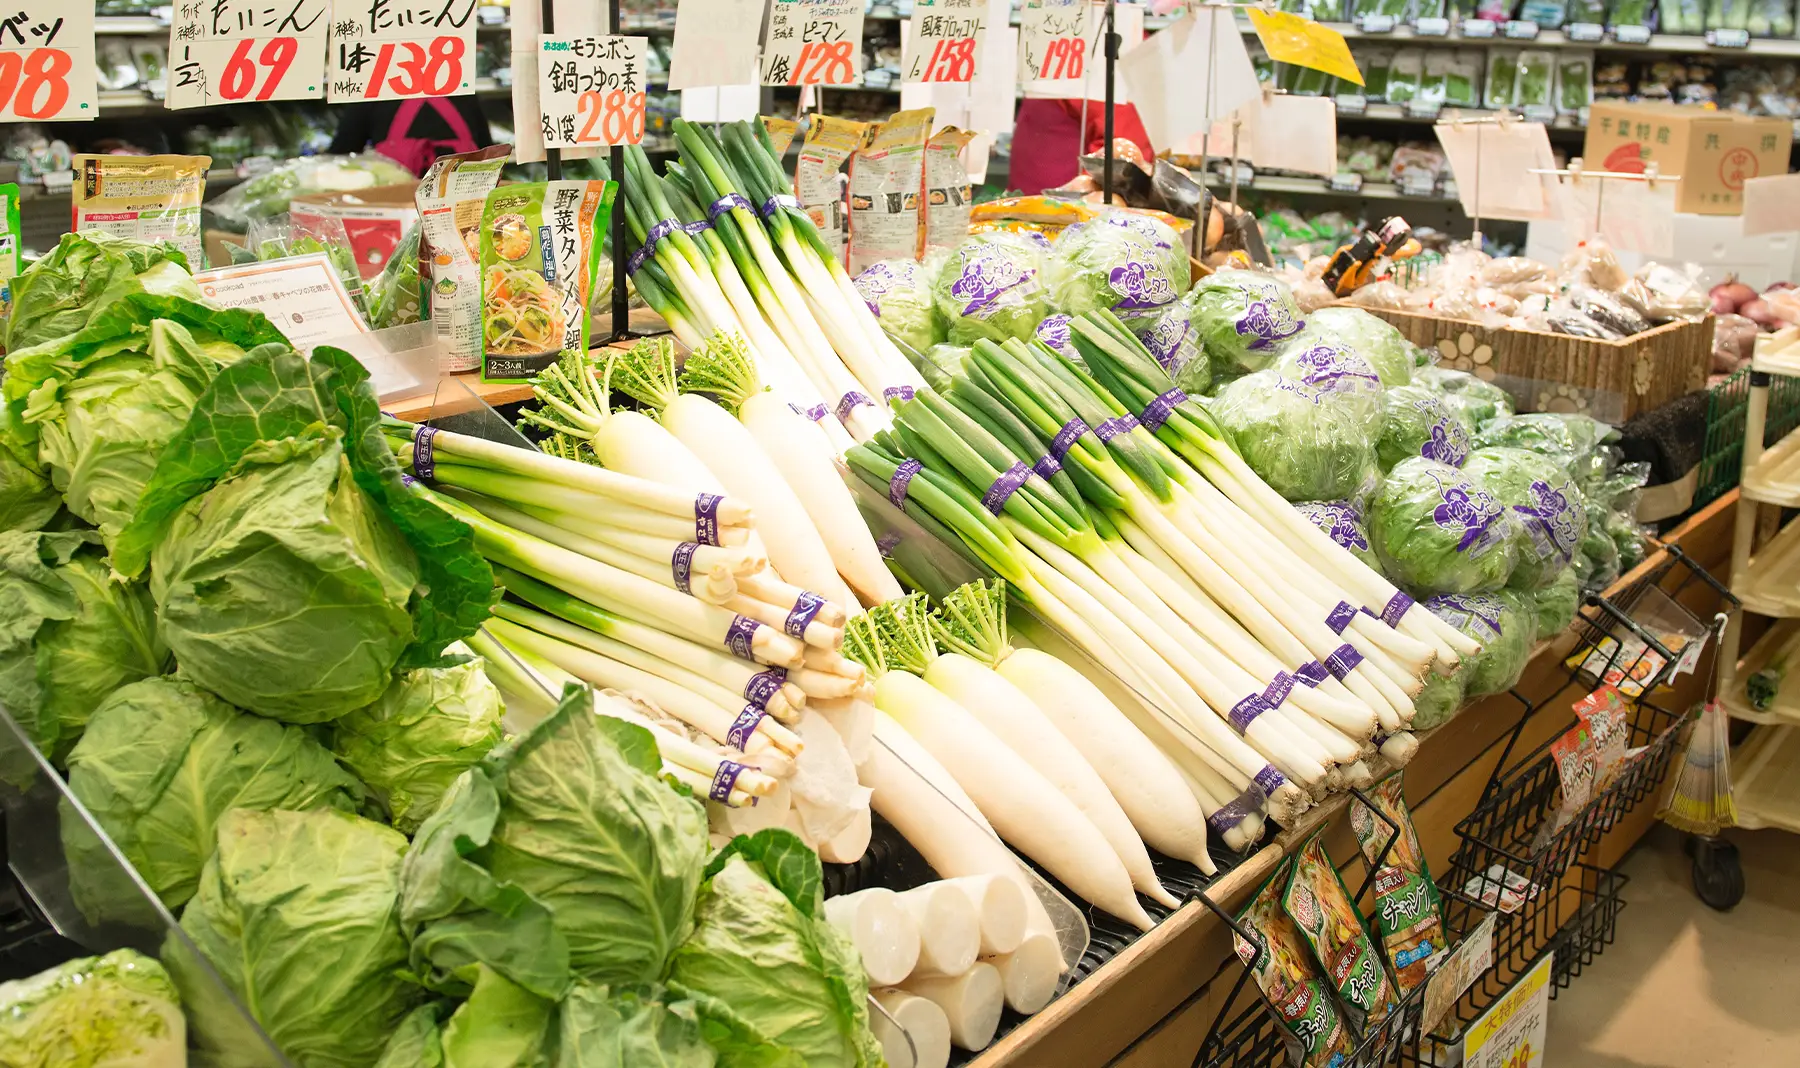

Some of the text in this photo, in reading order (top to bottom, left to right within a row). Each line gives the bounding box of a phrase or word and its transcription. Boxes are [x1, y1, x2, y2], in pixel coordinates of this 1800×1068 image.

[571, 38, 635, 59] モランボン
[802, 21, 846, 42] ピーマン
[219, 37, 298, 101] 69
[364, 36, 465, 98] 138
[548, 61, 637, 93] 鍋つゆの素
[787, 41, 853, 85] 128
[921, 38, 976, 82] 158
[1040, 38, 1085, 79] 198
[576, 89, 646, 145] 288
[554, 188, 581, 350] 野菜タンメン鍋
